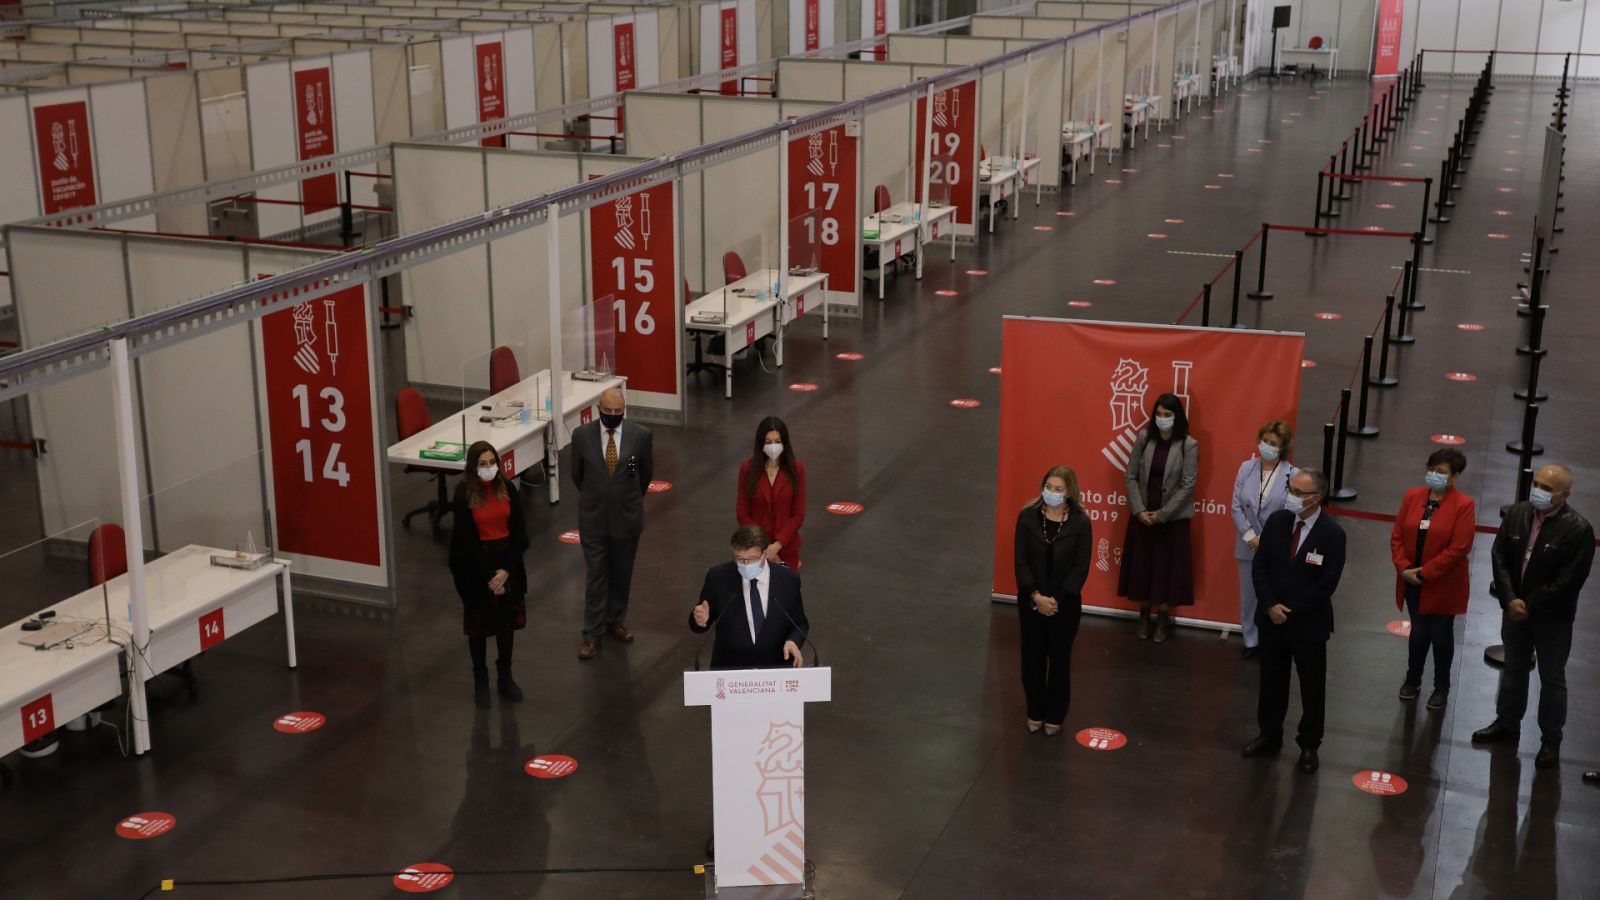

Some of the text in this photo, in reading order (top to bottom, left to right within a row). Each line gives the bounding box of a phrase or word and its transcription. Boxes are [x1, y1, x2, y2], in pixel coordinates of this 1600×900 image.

[931, 132, 961, 156] 19
[929, 160, 961, 185] 20
[804, 181, 840, 211] 17
[803, 216, 840, 246] 18
[611, 256, 655, 294] 15
[612, 299, 656, 335] 16
[292, 384, 346, 433] 13
[295, 438, 351, 487] 14
[503, 459, 513, 472] 15
[1079, 489, 1127, 506] nto de
[204, 620, 219, 638] 14
[728, 680, 776, 688] GENERALITAT
[29, 708, 47, 729] 13
